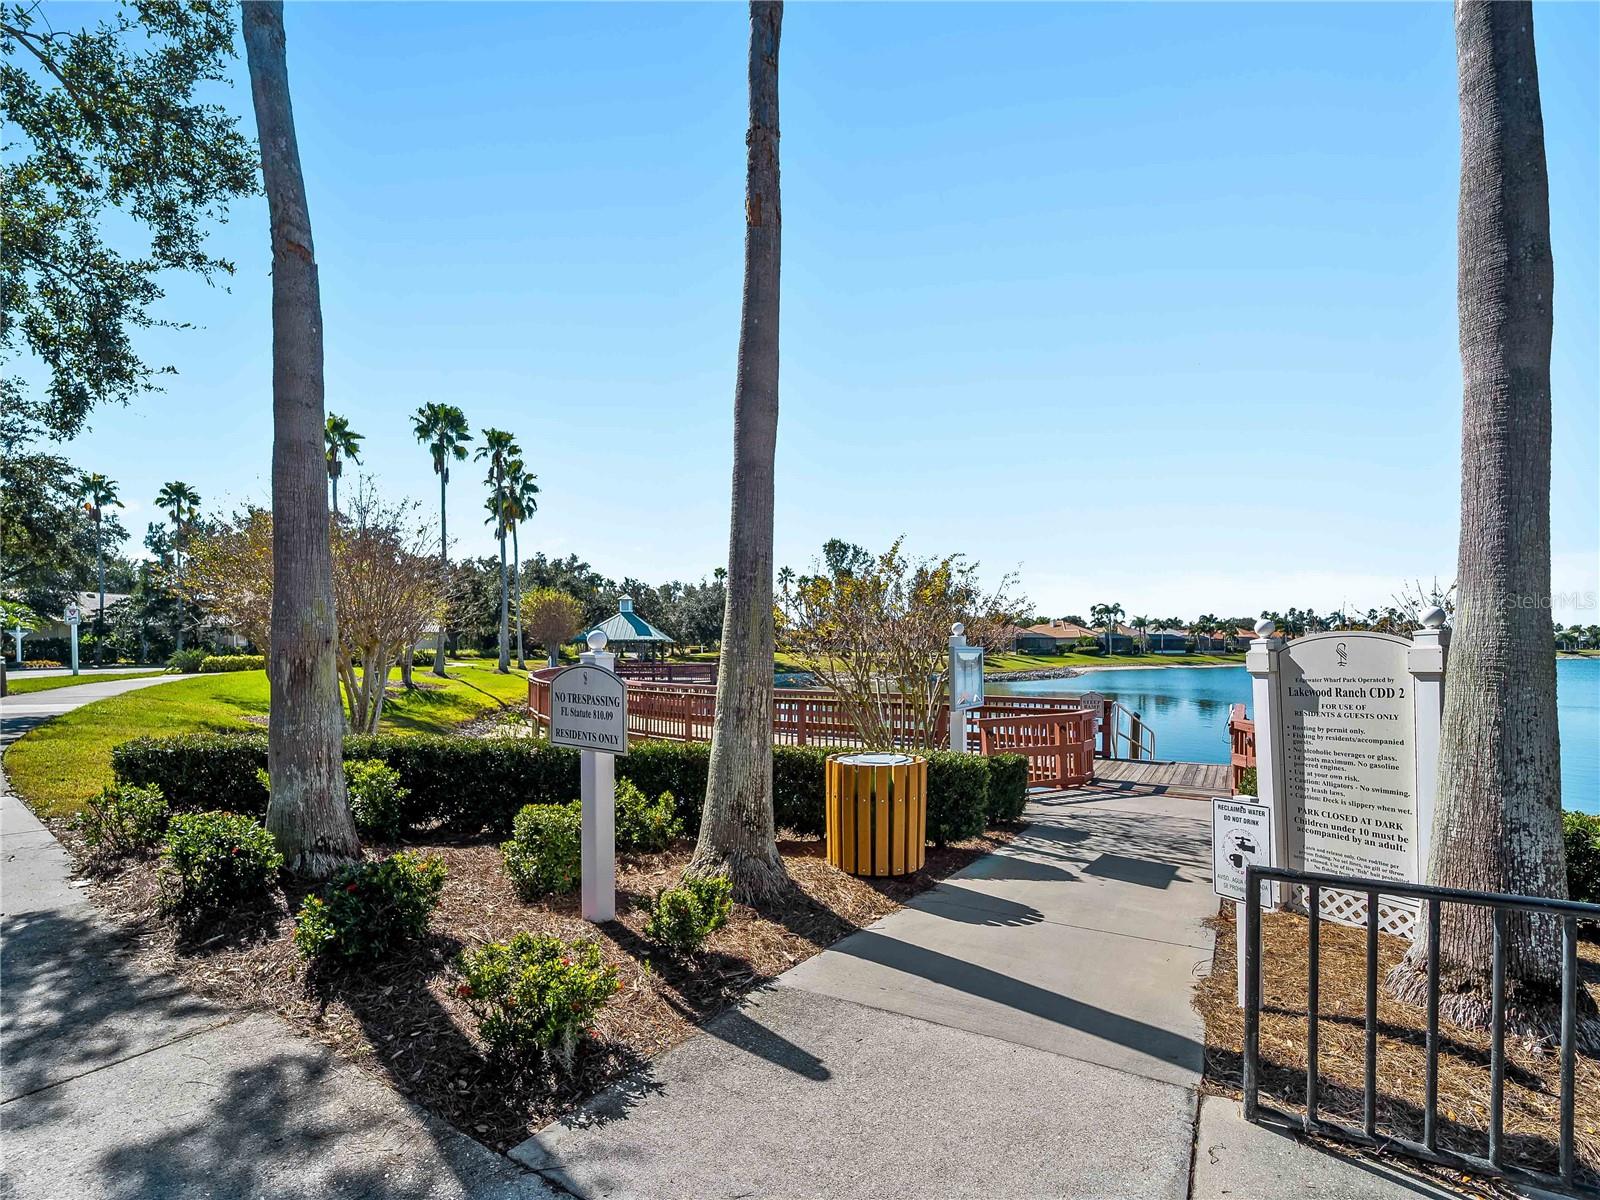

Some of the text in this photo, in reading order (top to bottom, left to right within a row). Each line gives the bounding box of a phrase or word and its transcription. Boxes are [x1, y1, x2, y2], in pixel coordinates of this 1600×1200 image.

[555, 692, 620, 707] NO TRESPASSING
[1288, 687, 1405, 698] Lakewood Ranch CDD 2
[561, 707, 613, 720] FL Statute 810.09
[555, 728, 619, 745] RESIDENTS ONLY
[1325, 736, 1404, 746] residents/accompanied
[1304, 748, 1332, 756] alcoholic
[1333, 751, 1365, 759] beverages
[1377, 754, 1397, 762] glass.
[1320, 763, 1346, 772] engines.
[1322, 757, 1356, 767] maximum.
[1370, 761, 1399, 771] gasoline
[1311, 786, 1327, 794] leash
[1329, 789, 1345, 797] laws.
[1322, 780, 1353, 790] Alligators
[1372, 786, 1410, 798] swimming.
[1218, 804, 1265, 817] RECLAIMED WATER
[1323, 796, 1339, 804] Deck
[1348, 800, 1374, 811] slippery
[1377, 804, 1395, 812] when
[1398, 807, 1413, 815] wet.
[1243, 818, 1259, 826] DRINK
[1297, 807, 1403, 831] PARK CLOSED AT DARK
[1294, 816, 1409, 844] Children under 10 must be
[1297, 826, 1406, 852] accompanied by an adult.
